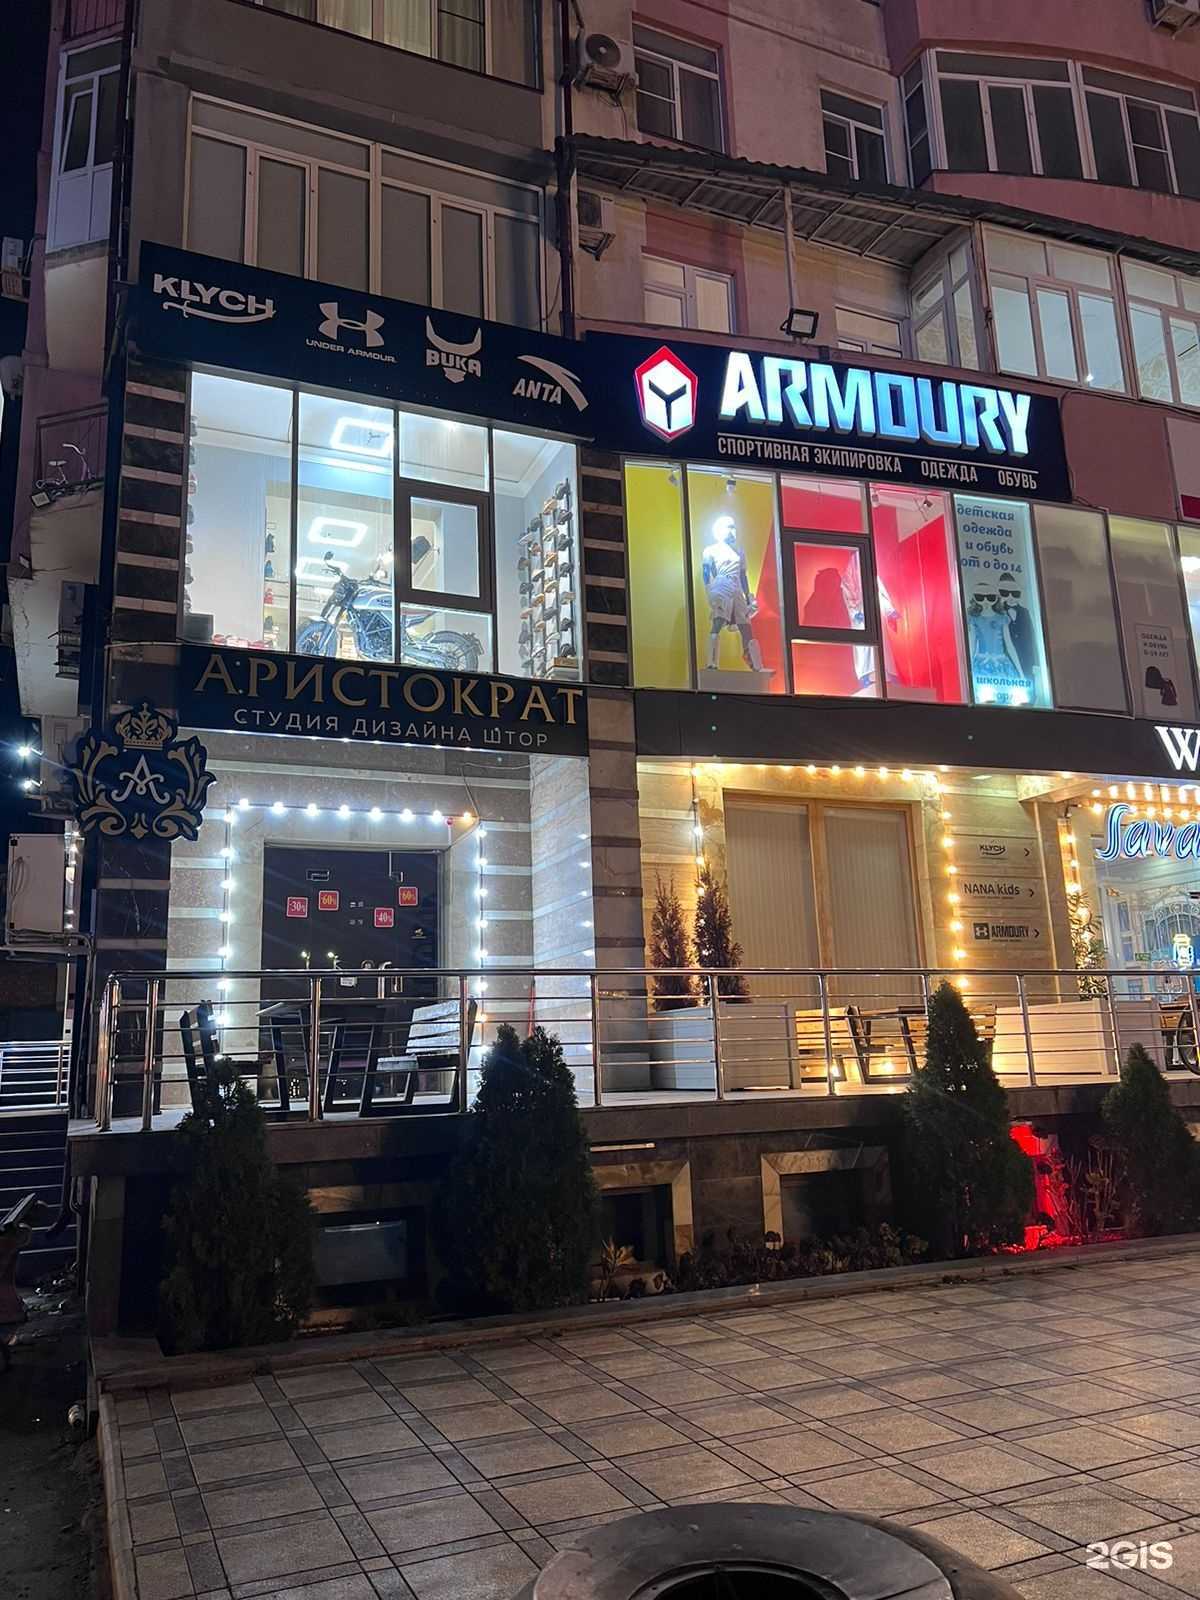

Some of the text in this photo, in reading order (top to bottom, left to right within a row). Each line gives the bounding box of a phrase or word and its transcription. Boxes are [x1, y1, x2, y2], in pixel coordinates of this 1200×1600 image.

[152, 273, 275, 314] KLYCH
[305, 338, 397, 363] UNDER ARMOUR
[512, 377, 562, 405] ANTA
[719, 351, 1031, 456] ARMOURY
[717, 437, 1038, 490] СПОРТИВНАЯ ЭКИПИРОВКА ОДЕЖДА ОБУВЬ
[957, 503, 1015, 521] детская
[963, 521, 1012, 538] одежда
[976, 541, 1014, 555] обувь
[960, 555, 980, 568] от
[993, 558, 1009, 571] до
[195, 653, 583, 724] АРИСТОКРАТ
[233, 707, 549, 748] СТУДИЯ ДИЗАЙНА ШТОР
[964, 883, 1020, 896] NANA kids
[991, 925, 1030, 938] ARMOURY
